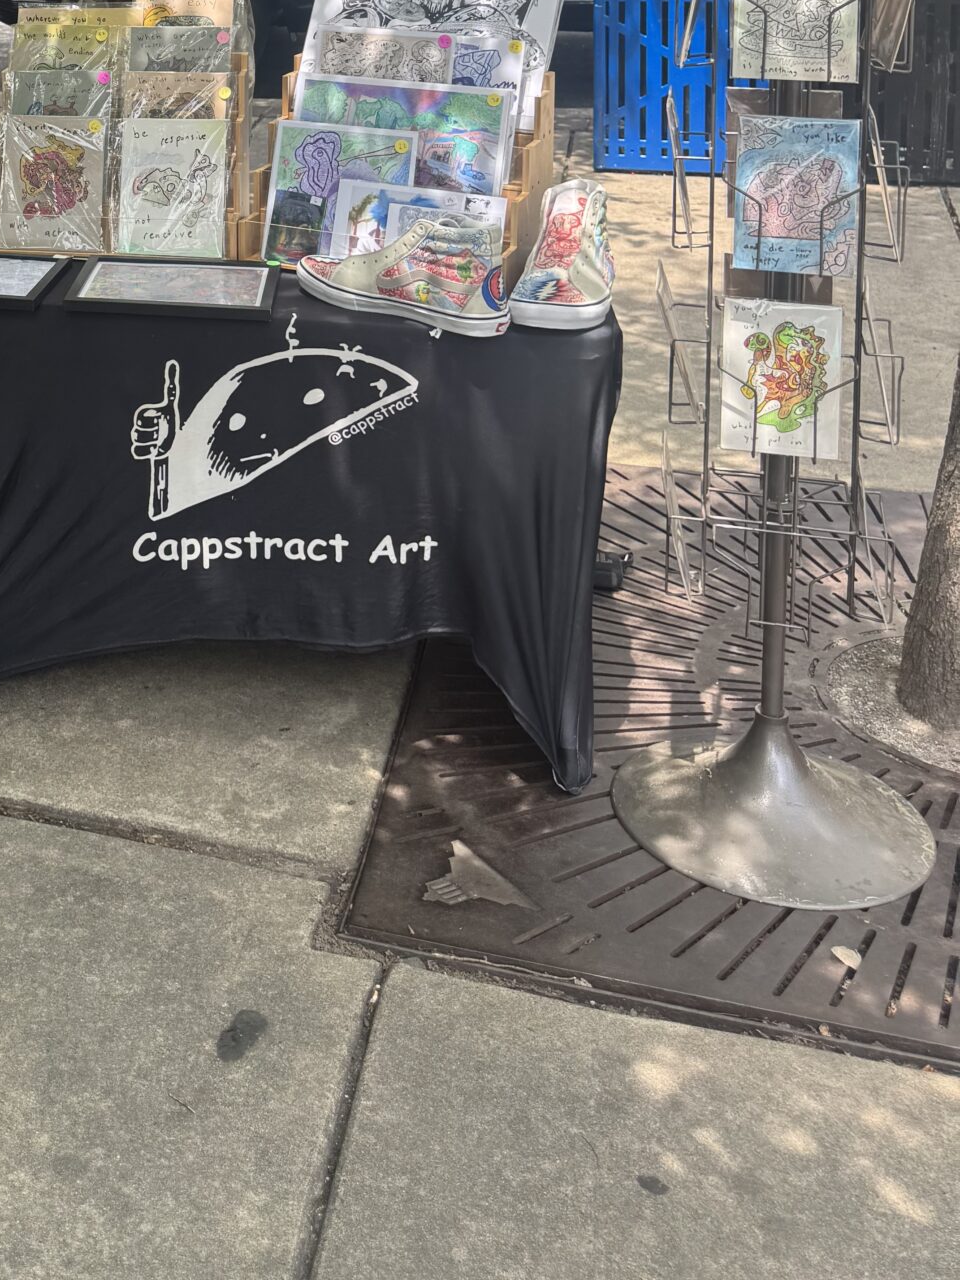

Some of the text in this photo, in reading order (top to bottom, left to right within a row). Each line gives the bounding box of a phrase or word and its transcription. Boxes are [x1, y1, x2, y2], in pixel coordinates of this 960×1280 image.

[760, 65, 798, 77] omething
[132, 126, 207, 147] be responsive
[804, 132, 847, 144] you like
[135, 214, 150, 225] not
[328, 391, 420, 446] @cappstract
[132, 530, 439, 570] Cappstract Art
